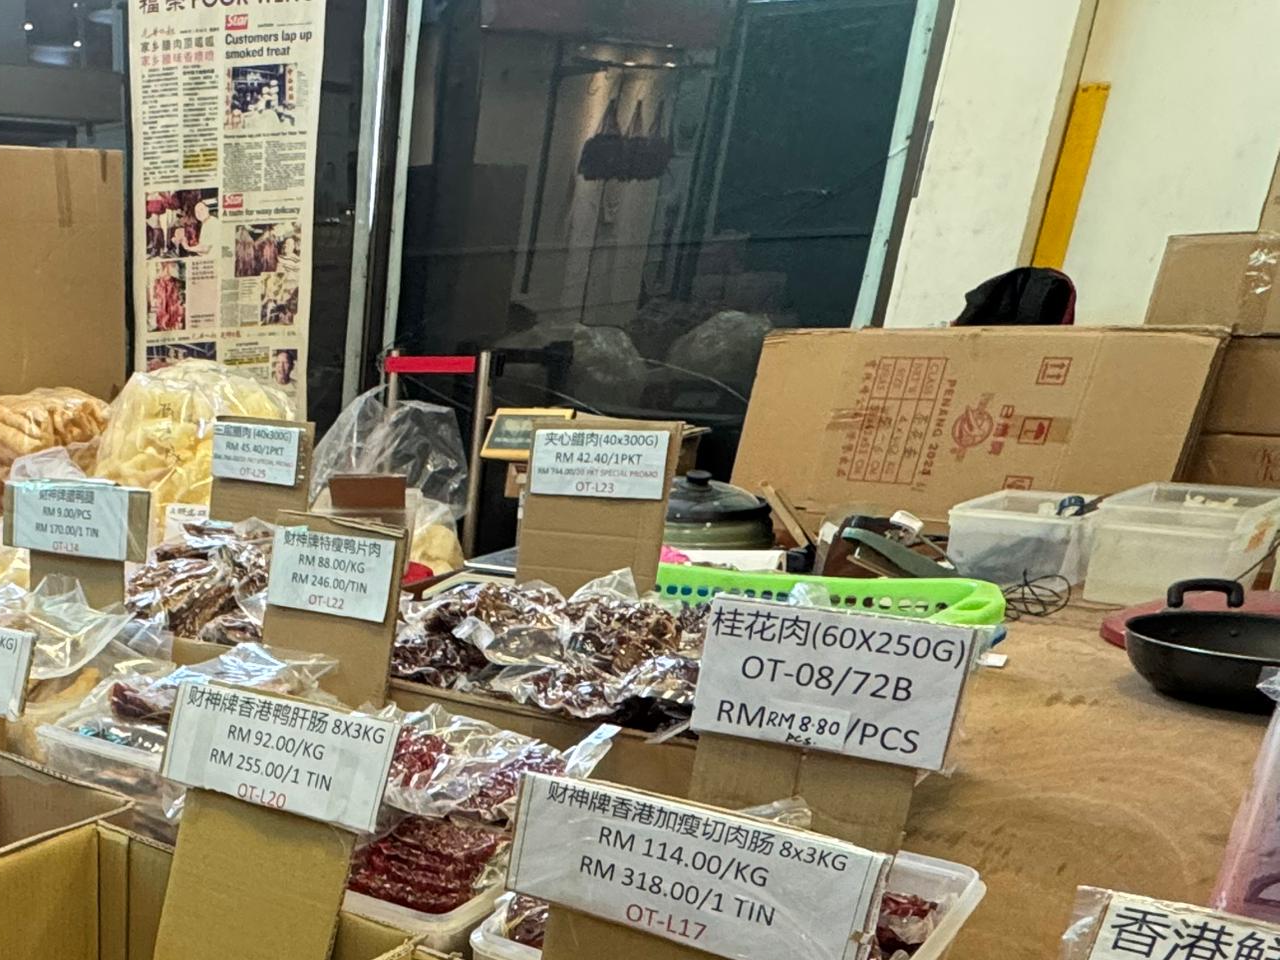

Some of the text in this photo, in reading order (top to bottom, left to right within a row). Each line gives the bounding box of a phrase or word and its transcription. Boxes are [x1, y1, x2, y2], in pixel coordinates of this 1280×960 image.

[225, 30, 313, 45] Customers lap up
[225, 46, 291, 59] smoked treat
[931, 378, 957, 438] PENANG
[225, 441, 239, 451] RM
[555, 452, 643, 466] RM 42.40/1PKT
[575, 481, 615, 494] OT-L23
[42, 506, 92, 521] RM 9.00/PCS
[35, 522, 99, 538] RM 170.00/1 TIN
[298, 554, 366, 575] RM 88.00/KG
[291, 572, 368, 595] RM 246.00/TIN
[308, 594, 346, 610] OT-L22
[711, 606, 966, 670] 桂花肉(60X250G)
[741, 655, 914, 702] OT-08/72B
[187, 685, 386, 745] 财神牌香港鸭肝肠 8X3KG
[716, 699, 920, 754] RM /PCS
[766, 711, 841, 736] RM 8.80
[227, 724, 326, 761] RM 92.00/KG
[209, 748, 333, 792] RM 255.00/1 TIN
[237, 783, 287, 809] OT-L20
[546, 781, 849, 872] 财神牌香港加瘦切肉肠 8x3KG
[598, 825, 770, 888] RM 114.00/KG
[579, 855, 777, 928] RM 318.00/1 TIN
[626, 903, 708, 942] OT-L17
